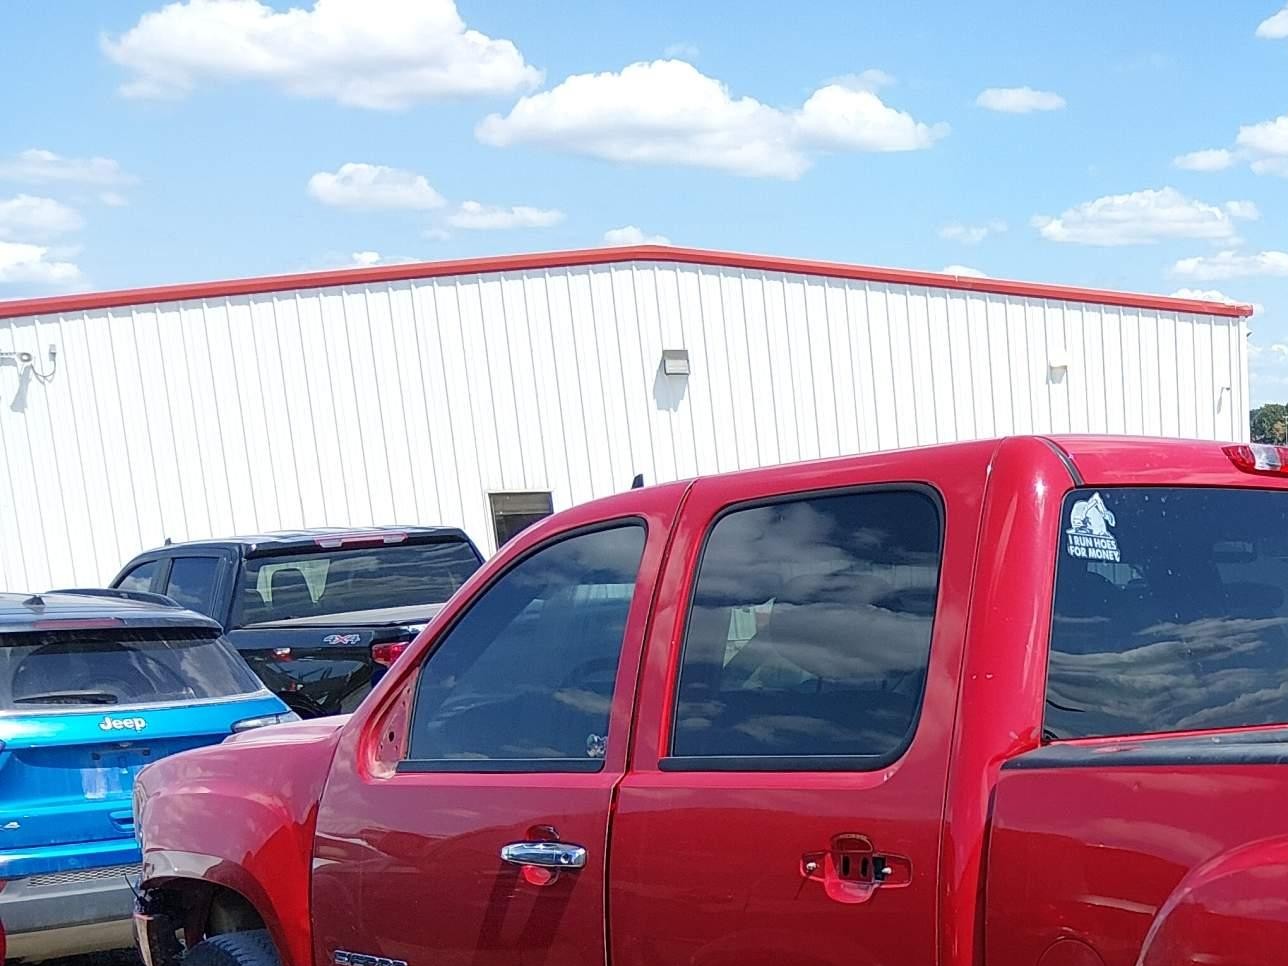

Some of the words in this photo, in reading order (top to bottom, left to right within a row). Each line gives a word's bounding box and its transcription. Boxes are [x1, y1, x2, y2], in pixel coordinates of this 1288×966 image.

[1073, 535, 1093, 547] RUN
[1093, 538, 1117, 550] HOES
[1069, 545, 1088, 557] FOR
[1088, 547, 1120, 563] MONEY
[99, 716, 146, 732] Jeep
